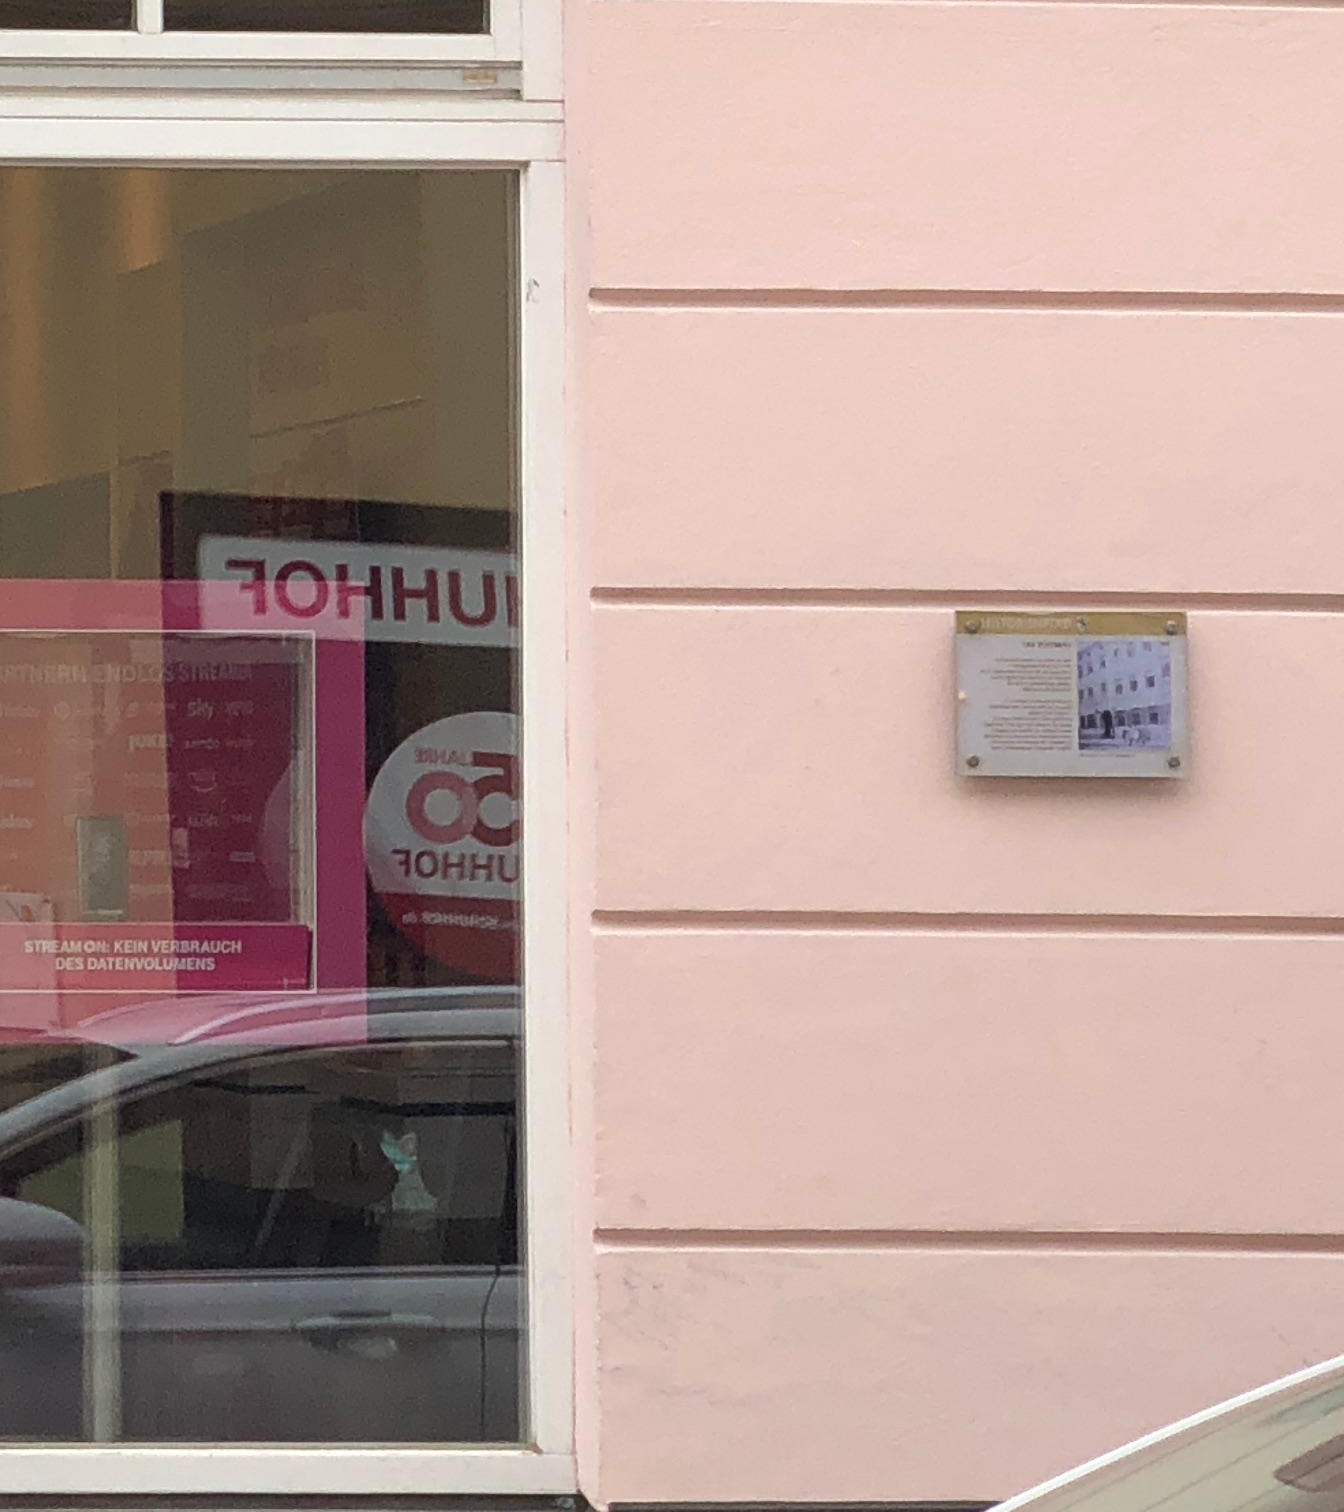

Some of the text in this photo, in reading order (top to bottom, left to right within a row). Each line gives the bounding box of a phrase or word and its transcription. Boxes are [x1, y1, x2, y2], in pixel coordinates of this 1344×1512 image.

[114, 941, 148, 954] KEIN
[151, 940, 242, 954] VERBRAUCH
[55, 958, 216, 971] DES DATENVOLUMENS
